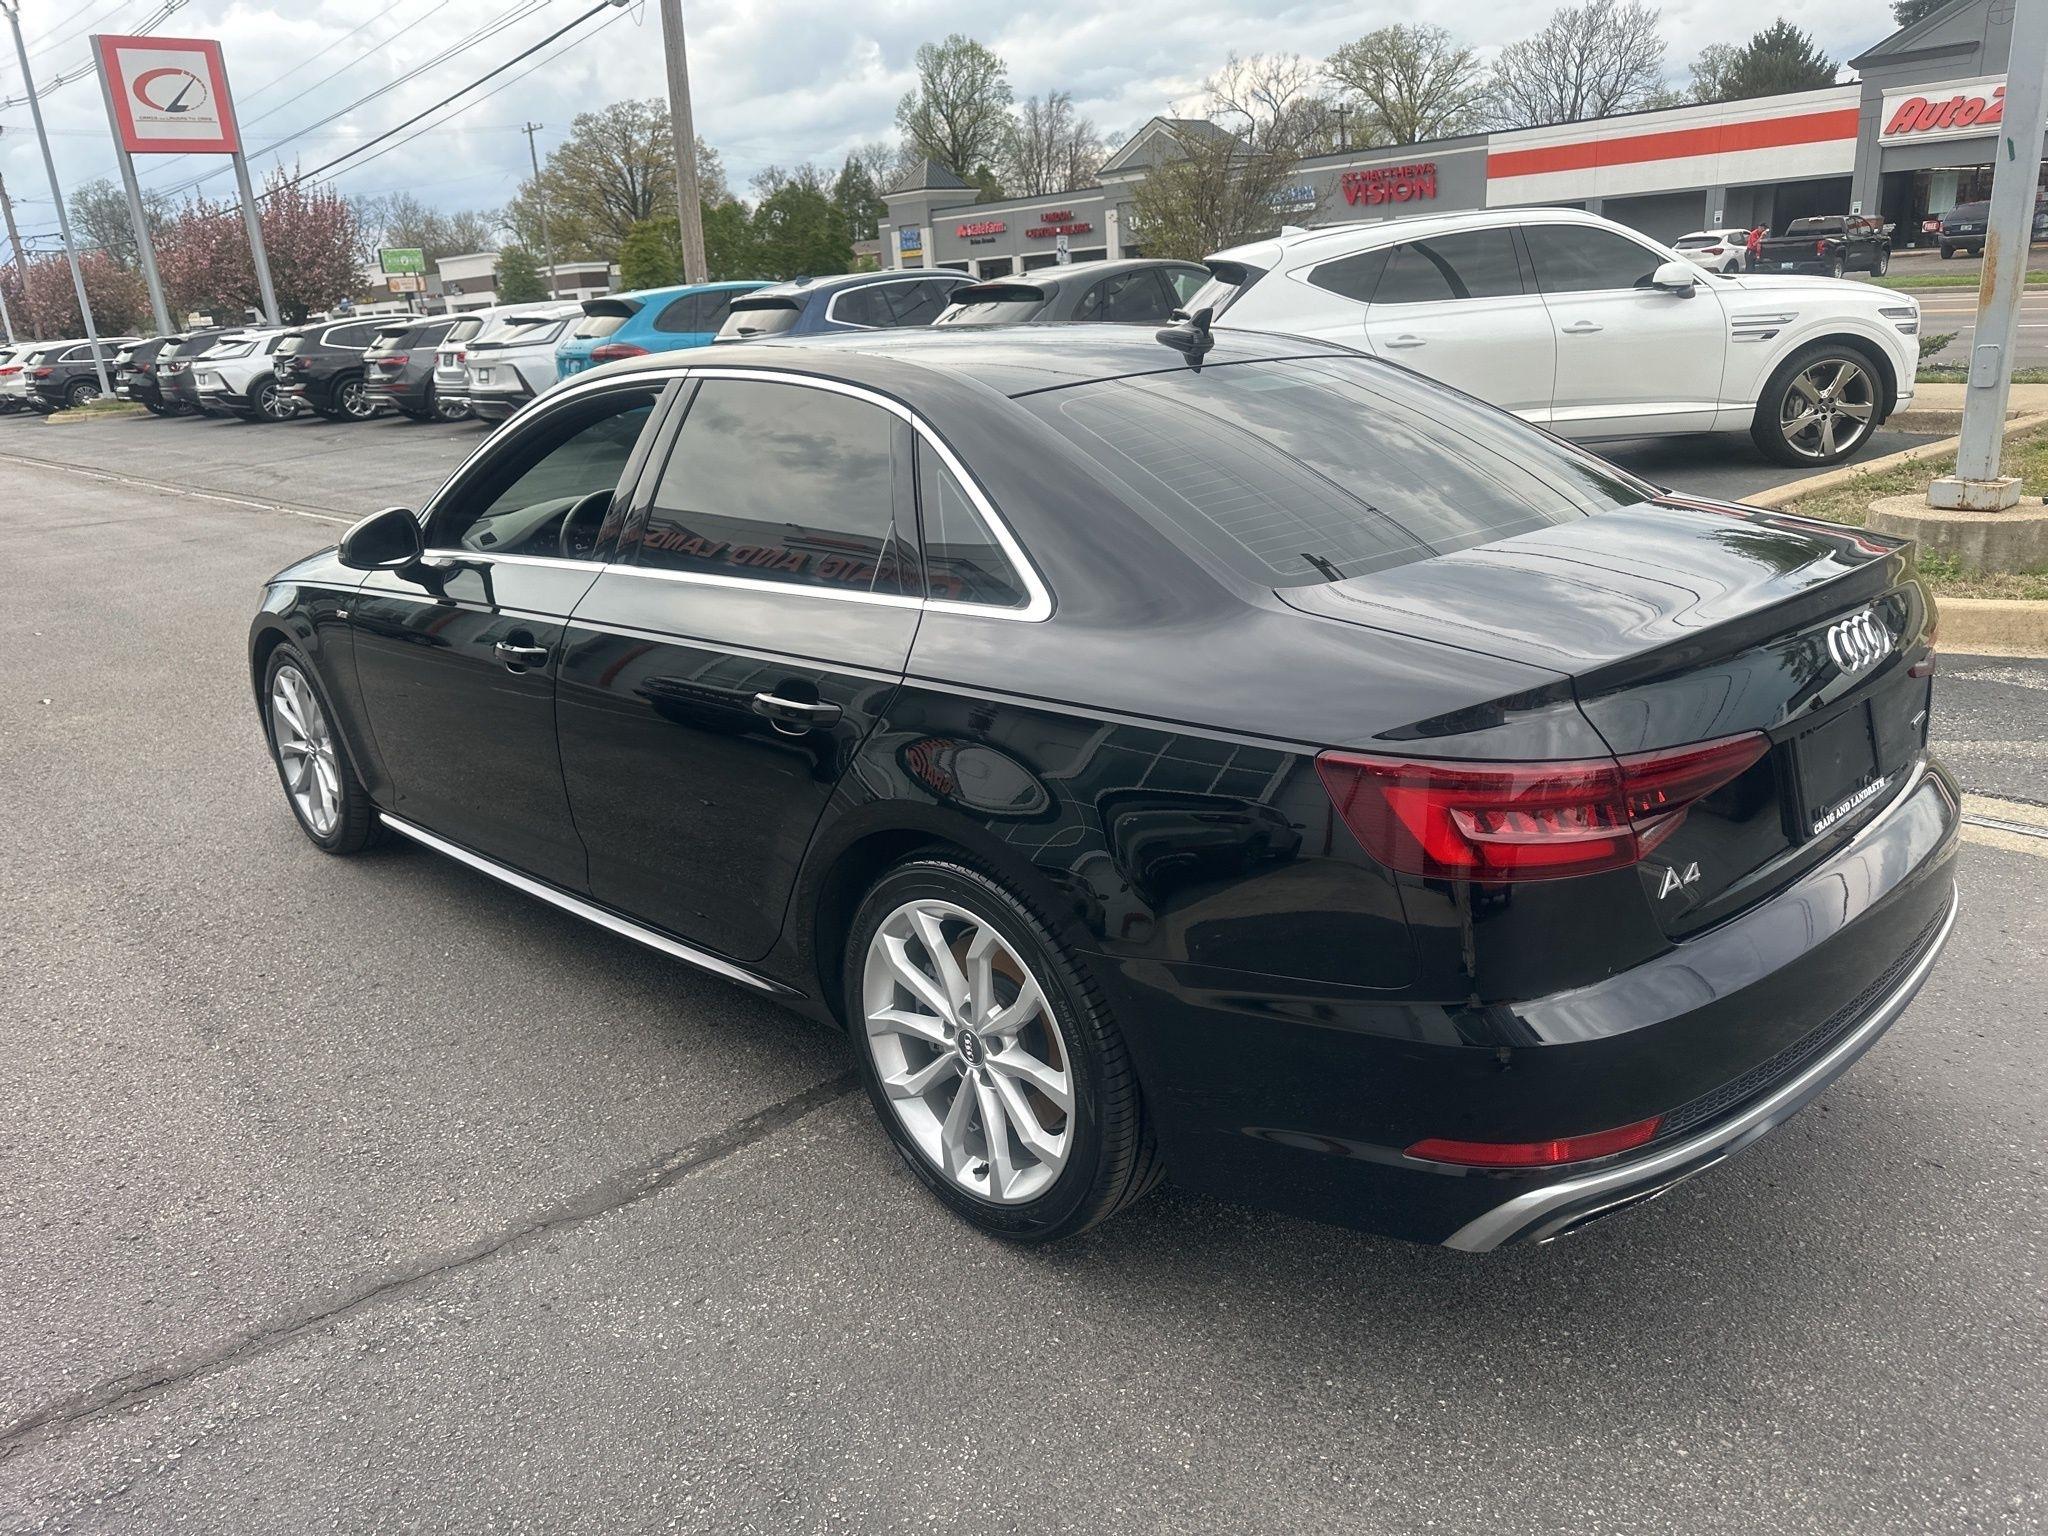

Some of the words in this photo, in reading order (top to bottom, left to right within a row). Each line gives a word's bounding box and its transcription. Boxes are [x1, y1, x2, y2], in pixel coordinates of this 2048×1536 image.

[1361, 163, 1436, 182] MATTHEWS
[1342, 176, 1436, 206] VISION
[1813, 812, 1836, 835] CRAIG
[1836, 802, 1851, 819] AND
[1850, 777, 1886, 808] LANDRETH
[1659, 861, 1701, 900] A4
